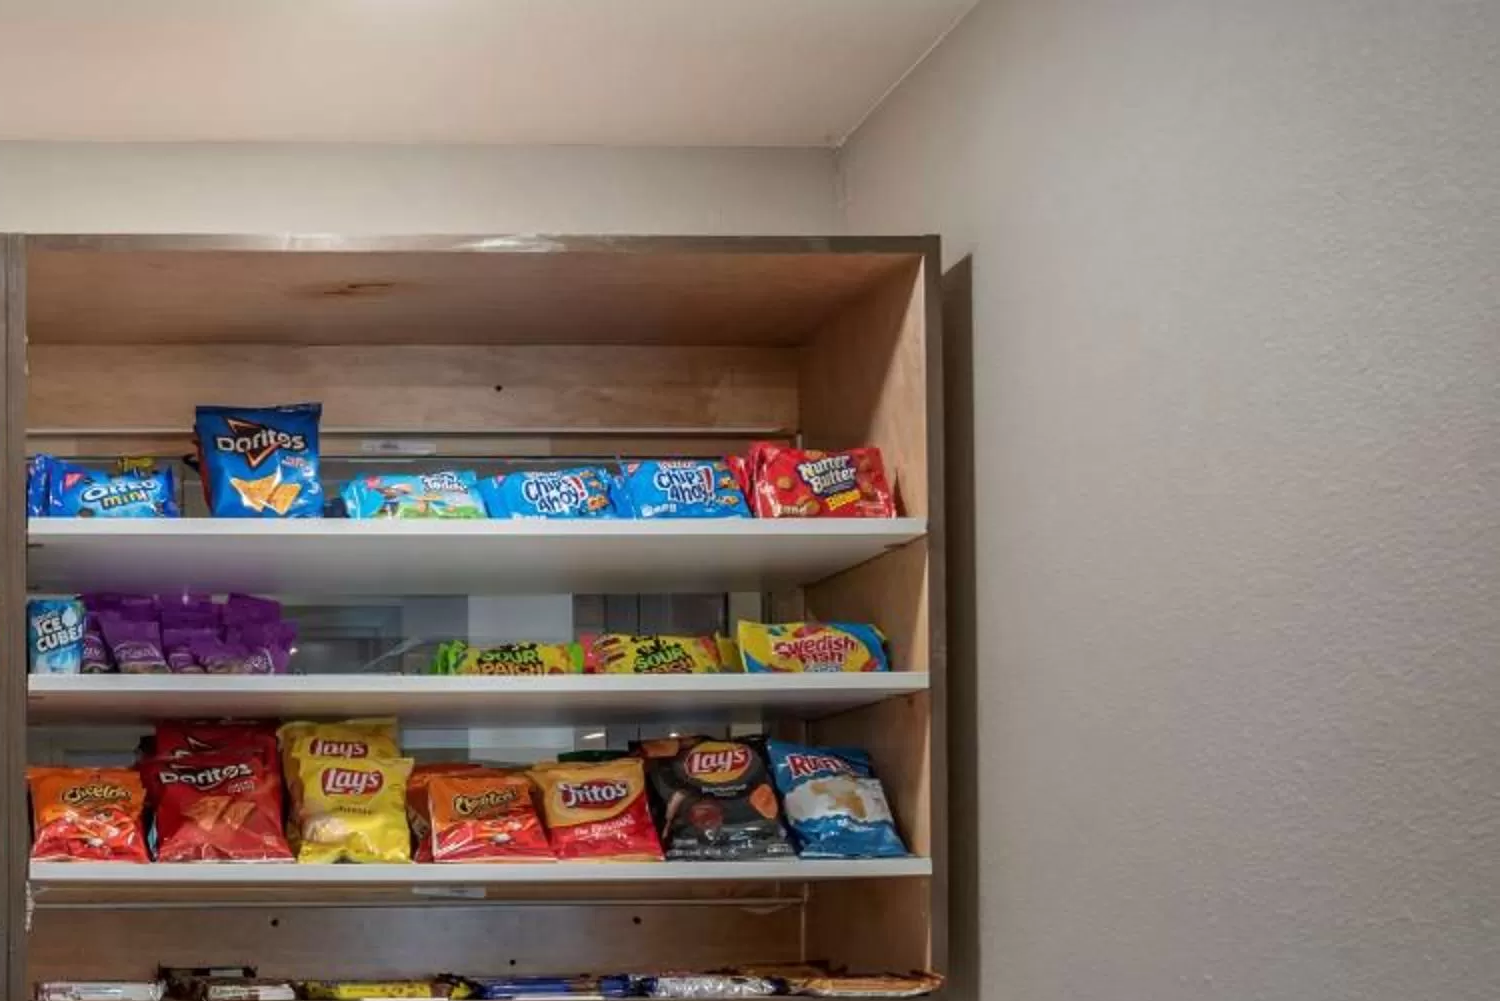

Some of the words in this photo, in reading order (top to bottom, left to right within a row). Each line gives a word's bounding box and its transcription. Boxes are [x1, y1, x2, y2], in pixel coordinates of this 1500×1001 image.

[216, 429, 305, 453] Doritos
[657, 469, 706, 487] Chips
[798, 456, 850, 479] Nutter
[810, 467, 856, 494] Butter
[37, 616, 62, 637] ICE
[482, 649, 538, 663] SOUR
[773, 634, 858, 657] Swedish
[636, 648, 684, 672] SOUR
[160, 763, 254, 786] Doritos
[557, 780, 628, 808] Fritos
